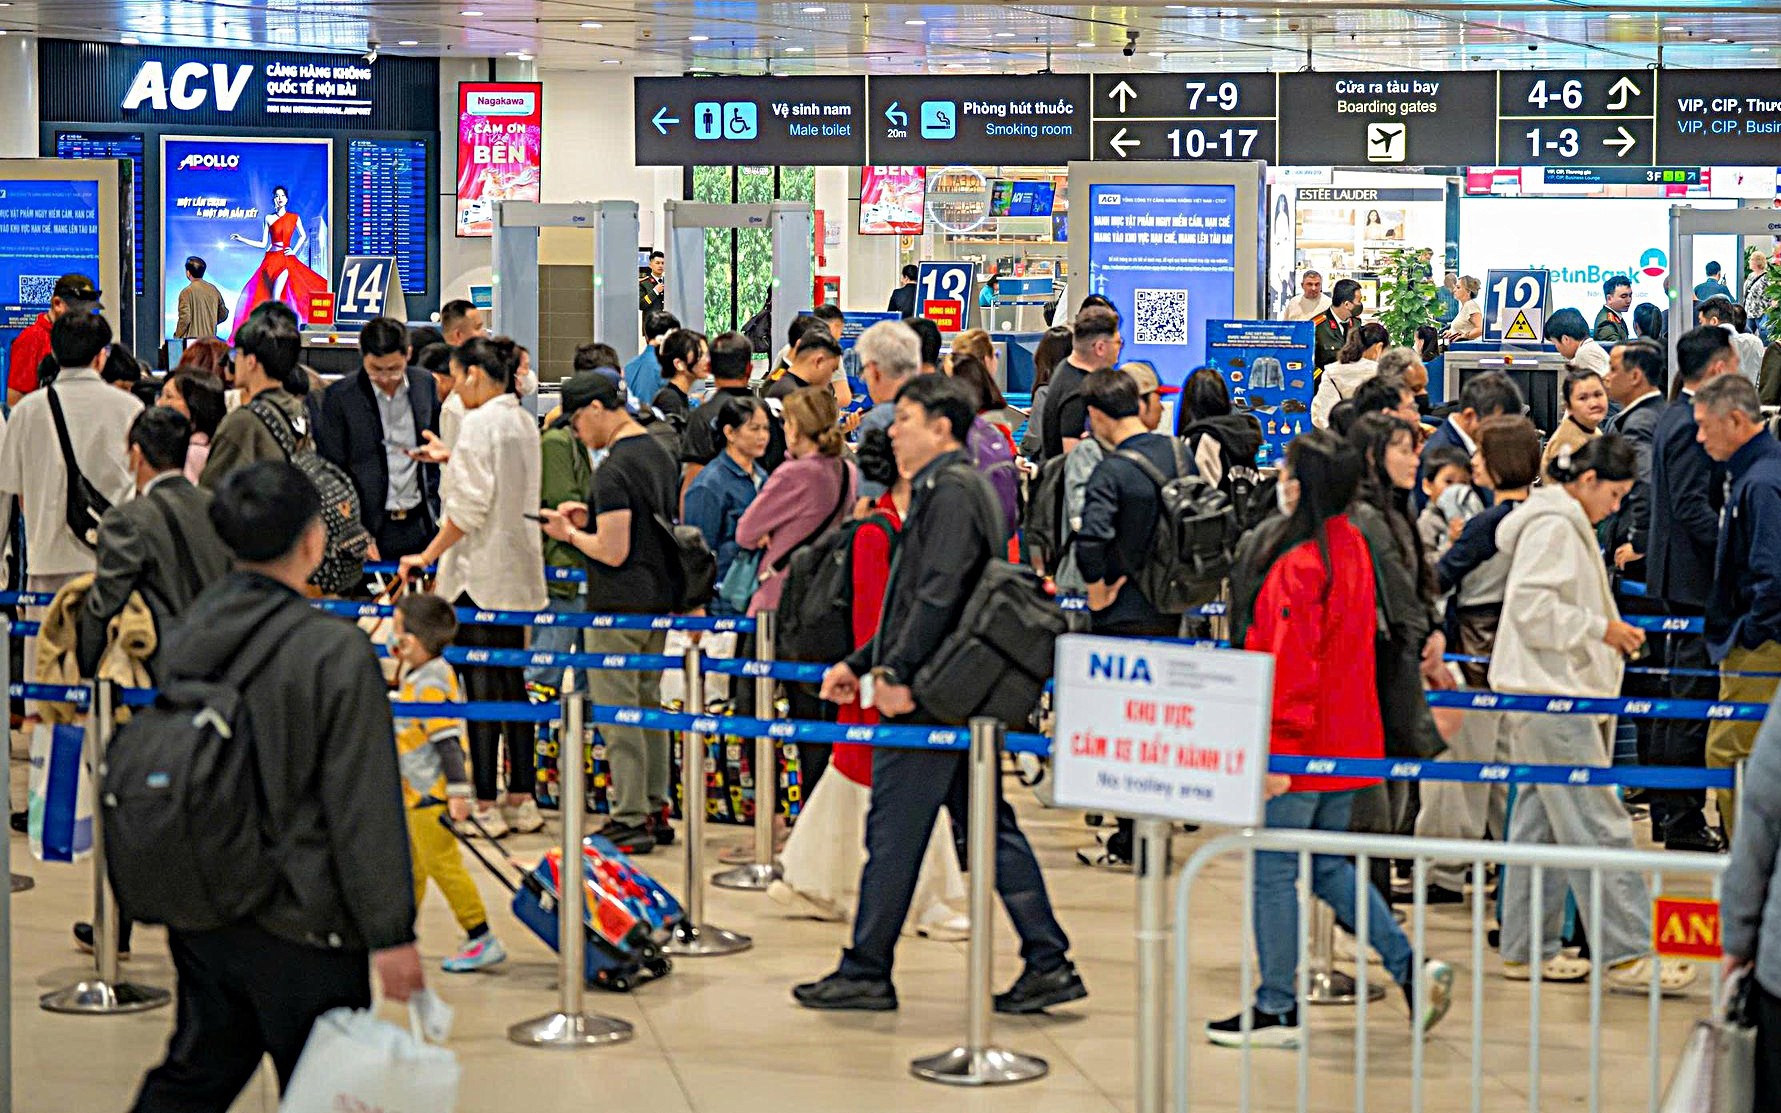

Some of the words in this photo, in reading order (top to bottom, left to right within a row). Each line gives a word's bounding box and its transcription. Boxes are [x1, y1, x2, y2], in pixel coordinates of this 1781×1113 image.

[266, 62, 298, 76] CẢNG
[300, 64, 331, 78] HÀNG
[333, 66, 372, 80] KHÔNG
[121, 60, 254, 111] ACV
[267, 79, 298, 95] QUỐC
[300, 79, 314, 94] TẾ
[316, 81, 335, 97] NỘI
[337, 81, 356, 96] BÀI
[1336, 80, 1365, 94] Cửa
[1369, 83, 1382, 93] ra
[1387, 80, 1408, 93] tàu
[1413, 80, 1439, 96] bay
[1528, 80, 1582, 109] 4-6
[478, 97, 524, 106] Nagakawa
[1186, 82, 1238, 111] 7-9
[772, 103, 789, 118] Vệ
[792, 103, 820, 116] sinh
[823, 105, 851, 115] nam
[964, 102, 1006, 117] Phòng
[1010, 102, 1032, 114] hút
[1034, 99, 1074, 114] thuốc
[1338, 100, 1396, 116] Boarding
[1400, 102, 1437, 116] gates
[1678, 99, 1708, 114] VIP,
[1712, 99, 1742, 114] CIP,
[474, 120, 503, 133] CẢM
[507, 122, 526, 133] ƠN
[790, 124, 818, 135] Male
[822, 124, 850, 135] toilet
[888, 129, 906, 138] 20m
[986, 123, 1037, 137] Smoking
[1042, 125, 1072, 134] room
[1678, 120, 1706, 135] VIP,
[1711, 120, 1741, 135] CIP,
[1168, 129, 1258, 157] 10-17
[1526, 128, 1579, 157] 1-3
[474, 140, 525, 164] BÊN
[177, 154, 239, 170] APOLLO
[1646, 171, 1661, 181] 3F
[1334, 189, 1378, 200] LAUDER
[340, 263, 383, 314] 14
[919, 268, 966, 318] 13
[928, 306, 943, 314] ĐÓNG
[1490, 276, 1540, 331] 12
[1060, 598, 1086, 610] ACV
[1200, 602, 1226, 614] ACV
[358, 605, 378, 615] ACV
[475, 611, 496, 622] ACV
[534, 613, 555, 624] ACV
[592, 615, 614, 627] ACV
[651, 617, 673, 628] ACV
[714, 619, 736, 630] ACV
[1663, 618, 1688, 630] ACV
[466, 650, 490, 662] ACV
[531, 653, 554, 664] ACV
[603, 655, 626, 667] ACV
[742, 661, 771, 675] ACV
[1090, 653, 1152, 683] NIA
[65, 689, 88, 700] ACV
[1125, 700, 1156, 725] KHU
[1163, 702, 1195, 728] VỰC
[1472, 695, 1498, 707] ACV
[1547, 700, 1573, 712] ACV
[1624, 701, 1652, 714] ACV
[1707, 705, 1734, 718] ACV
[615, 709, 643, 723] ACV
[928, 730, 957, 744] ACV
[1072, 727, 1108, 757] CẤM
[1115, 737, 1133, 762] XE
[1176, 745, 1220, 771] HÀNH
[1226, 748, 1245, 775] LÝ
[1306, 760, 1336, 774] ACV
[1390, 762, 1421, 777] ACV
[1478, 764, 1510, 779] ACV
[1125, 774, 1173, 795] trolley
[1180, 785, 1214, 799] area
